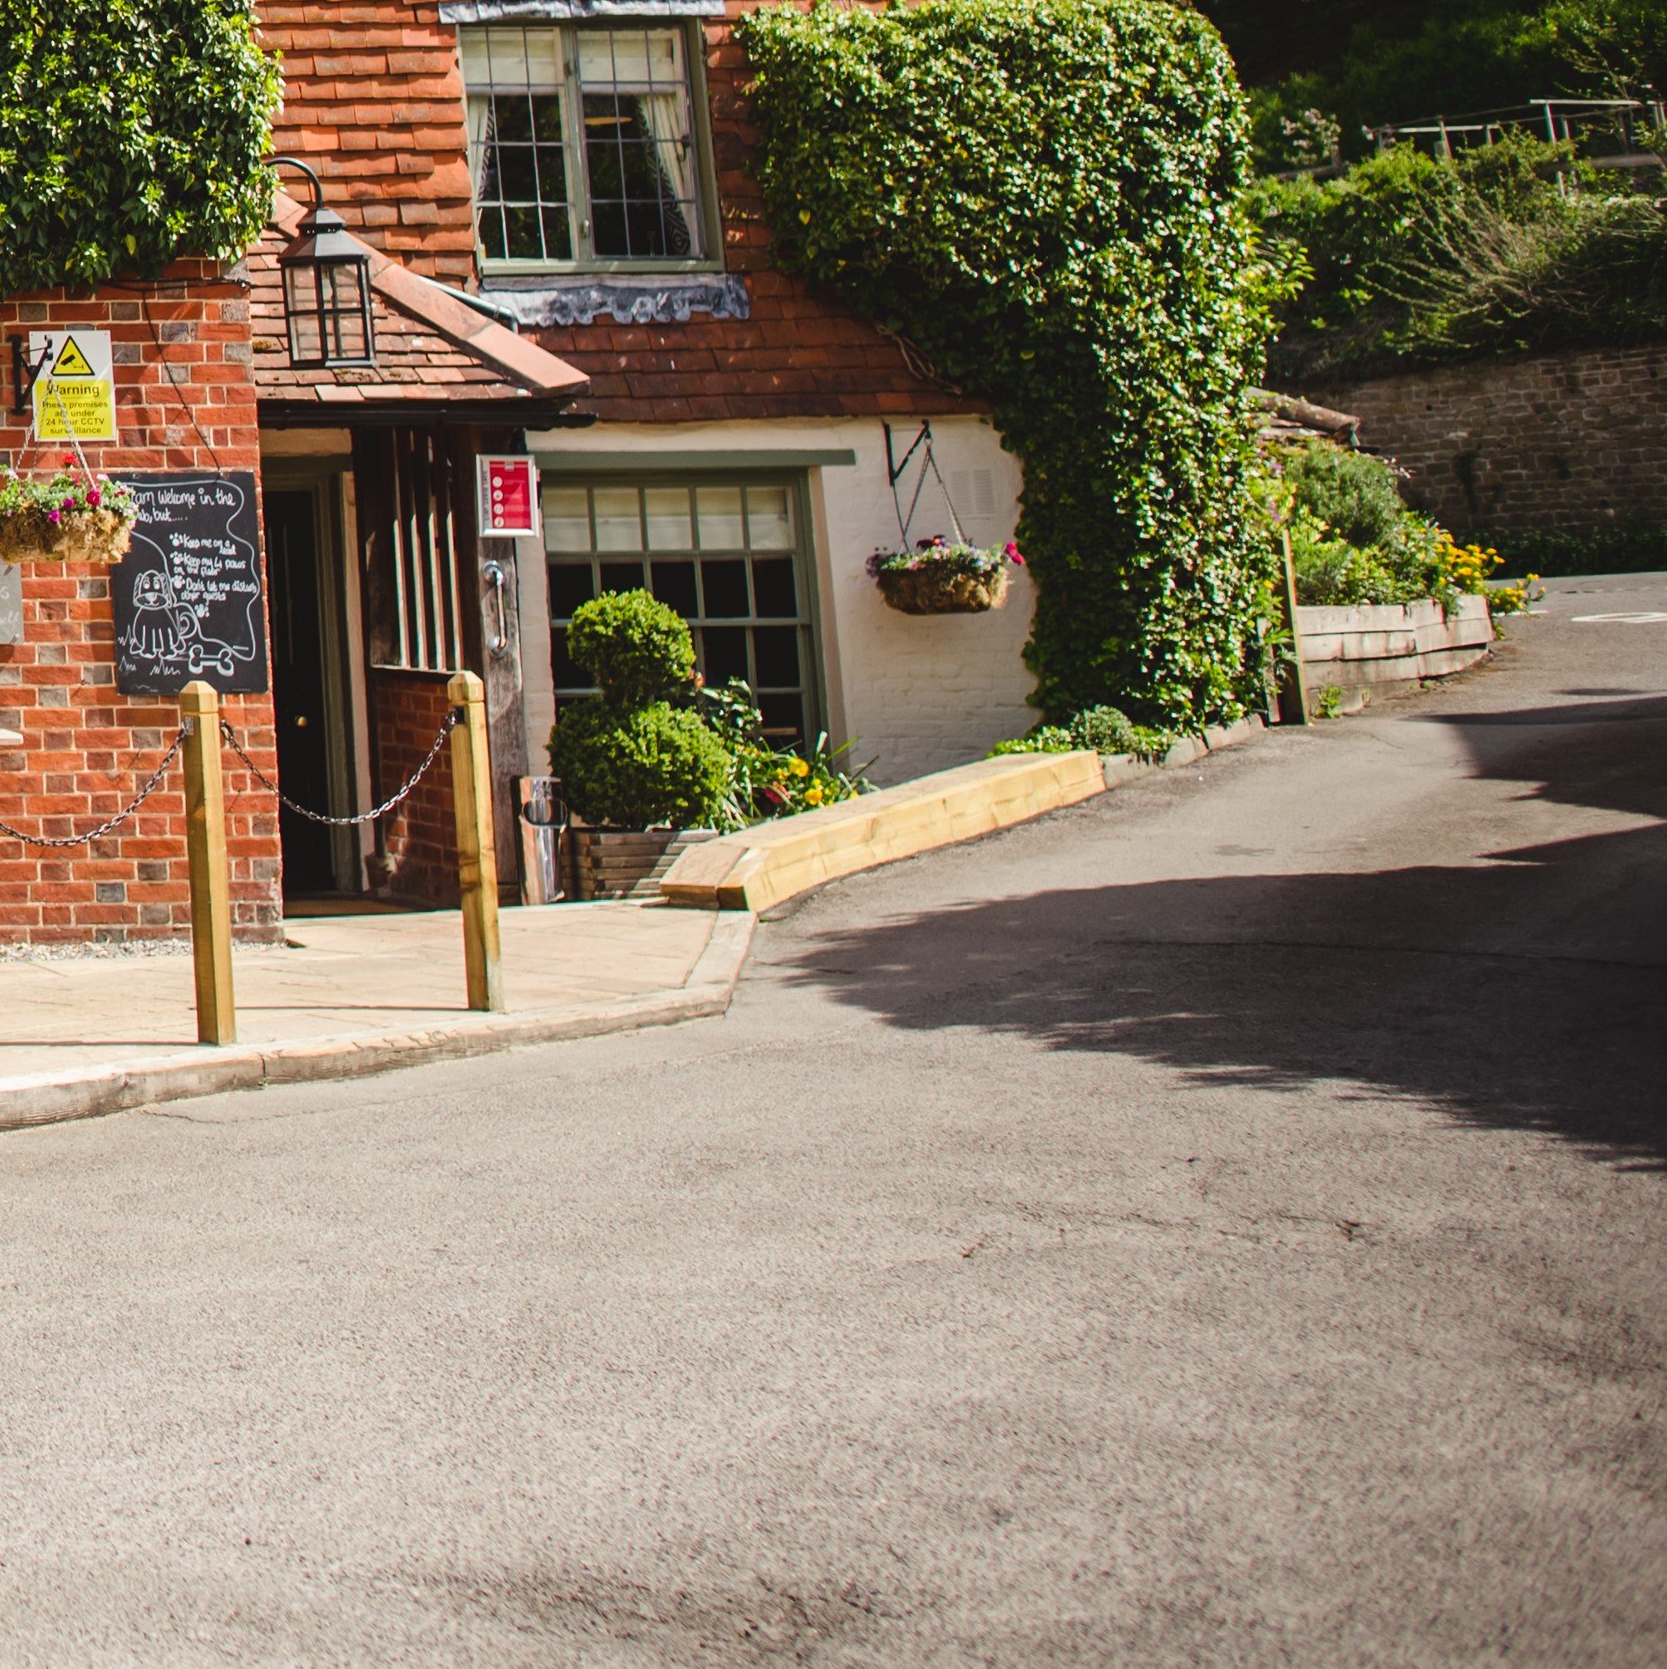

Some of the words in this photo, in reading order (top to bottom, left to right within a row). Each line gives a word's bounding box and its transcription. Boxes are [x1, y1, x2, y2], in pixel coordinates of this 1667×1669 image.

[69, 401, 108, 410] premises
[70, 409, 95, 417] under
[46, 418, 55, 426] 24
[80, 417, 105, 425] CCTV
[158, 488, 196, 509] Welcome
[198, 487, 214, 506] in
[216, 488, 236, 506] the
[183, 533, 200, 549] Keep
[183, 552, 200, 568] Keep
[225, 559, 246, 570] paws
